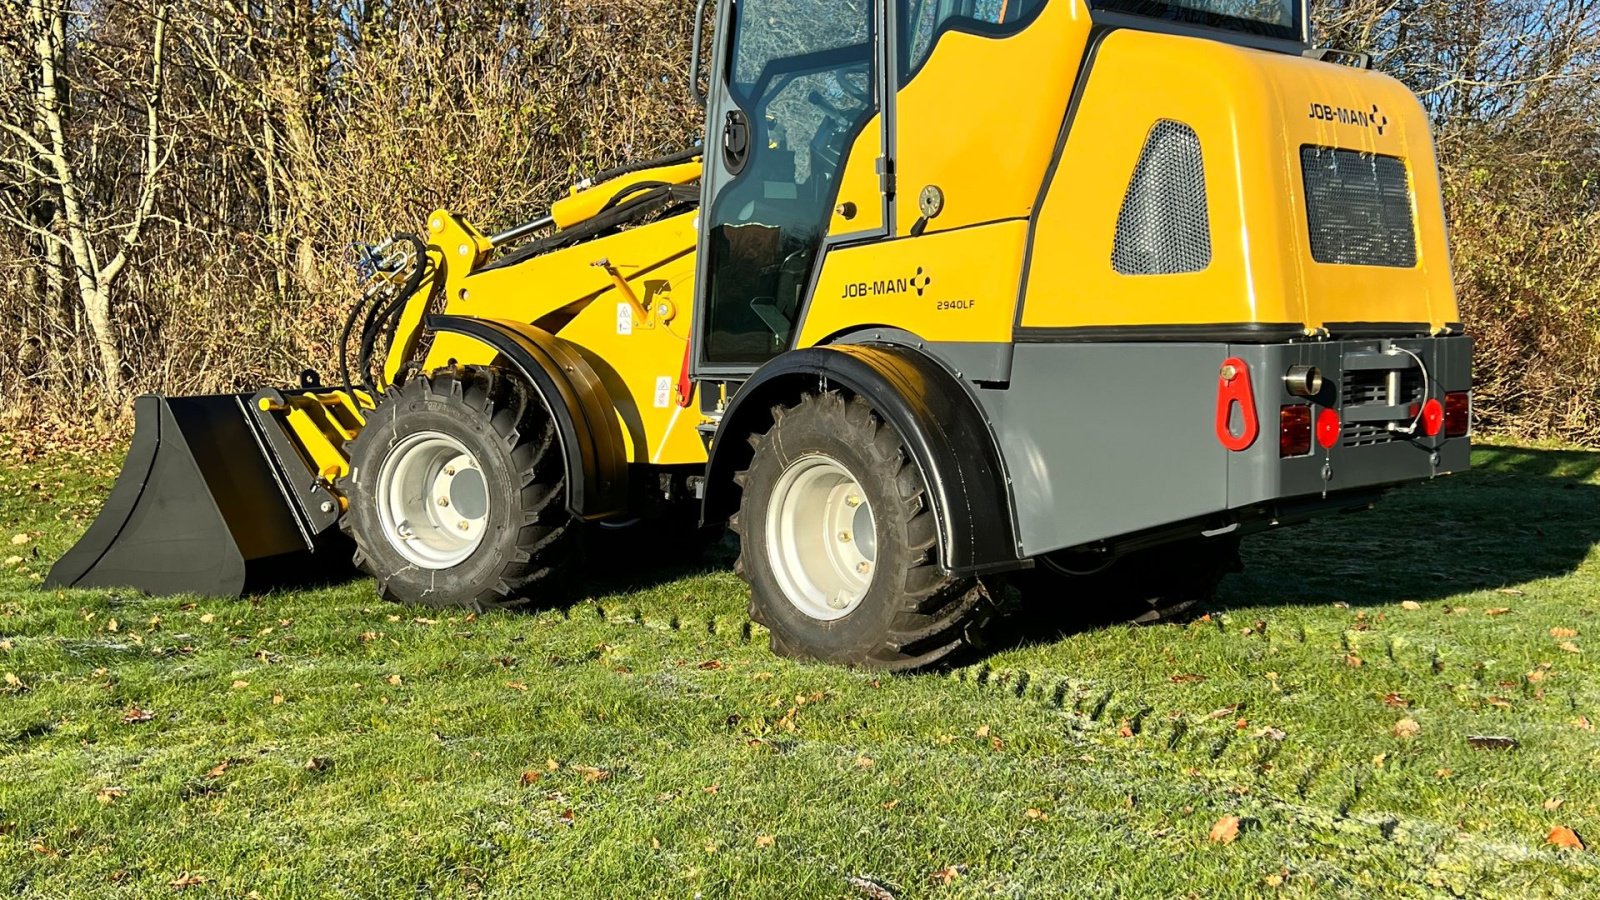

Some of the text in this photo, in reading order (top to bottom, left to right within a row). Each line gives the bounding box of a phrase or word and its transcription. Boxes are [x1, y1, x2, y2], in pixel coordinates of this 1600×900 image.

[1308, 102, 1369, 127] JOB-MAN
[841, 278, 907, 299] JOB-MAN
[936, 299, 975, 310] 2940LF
